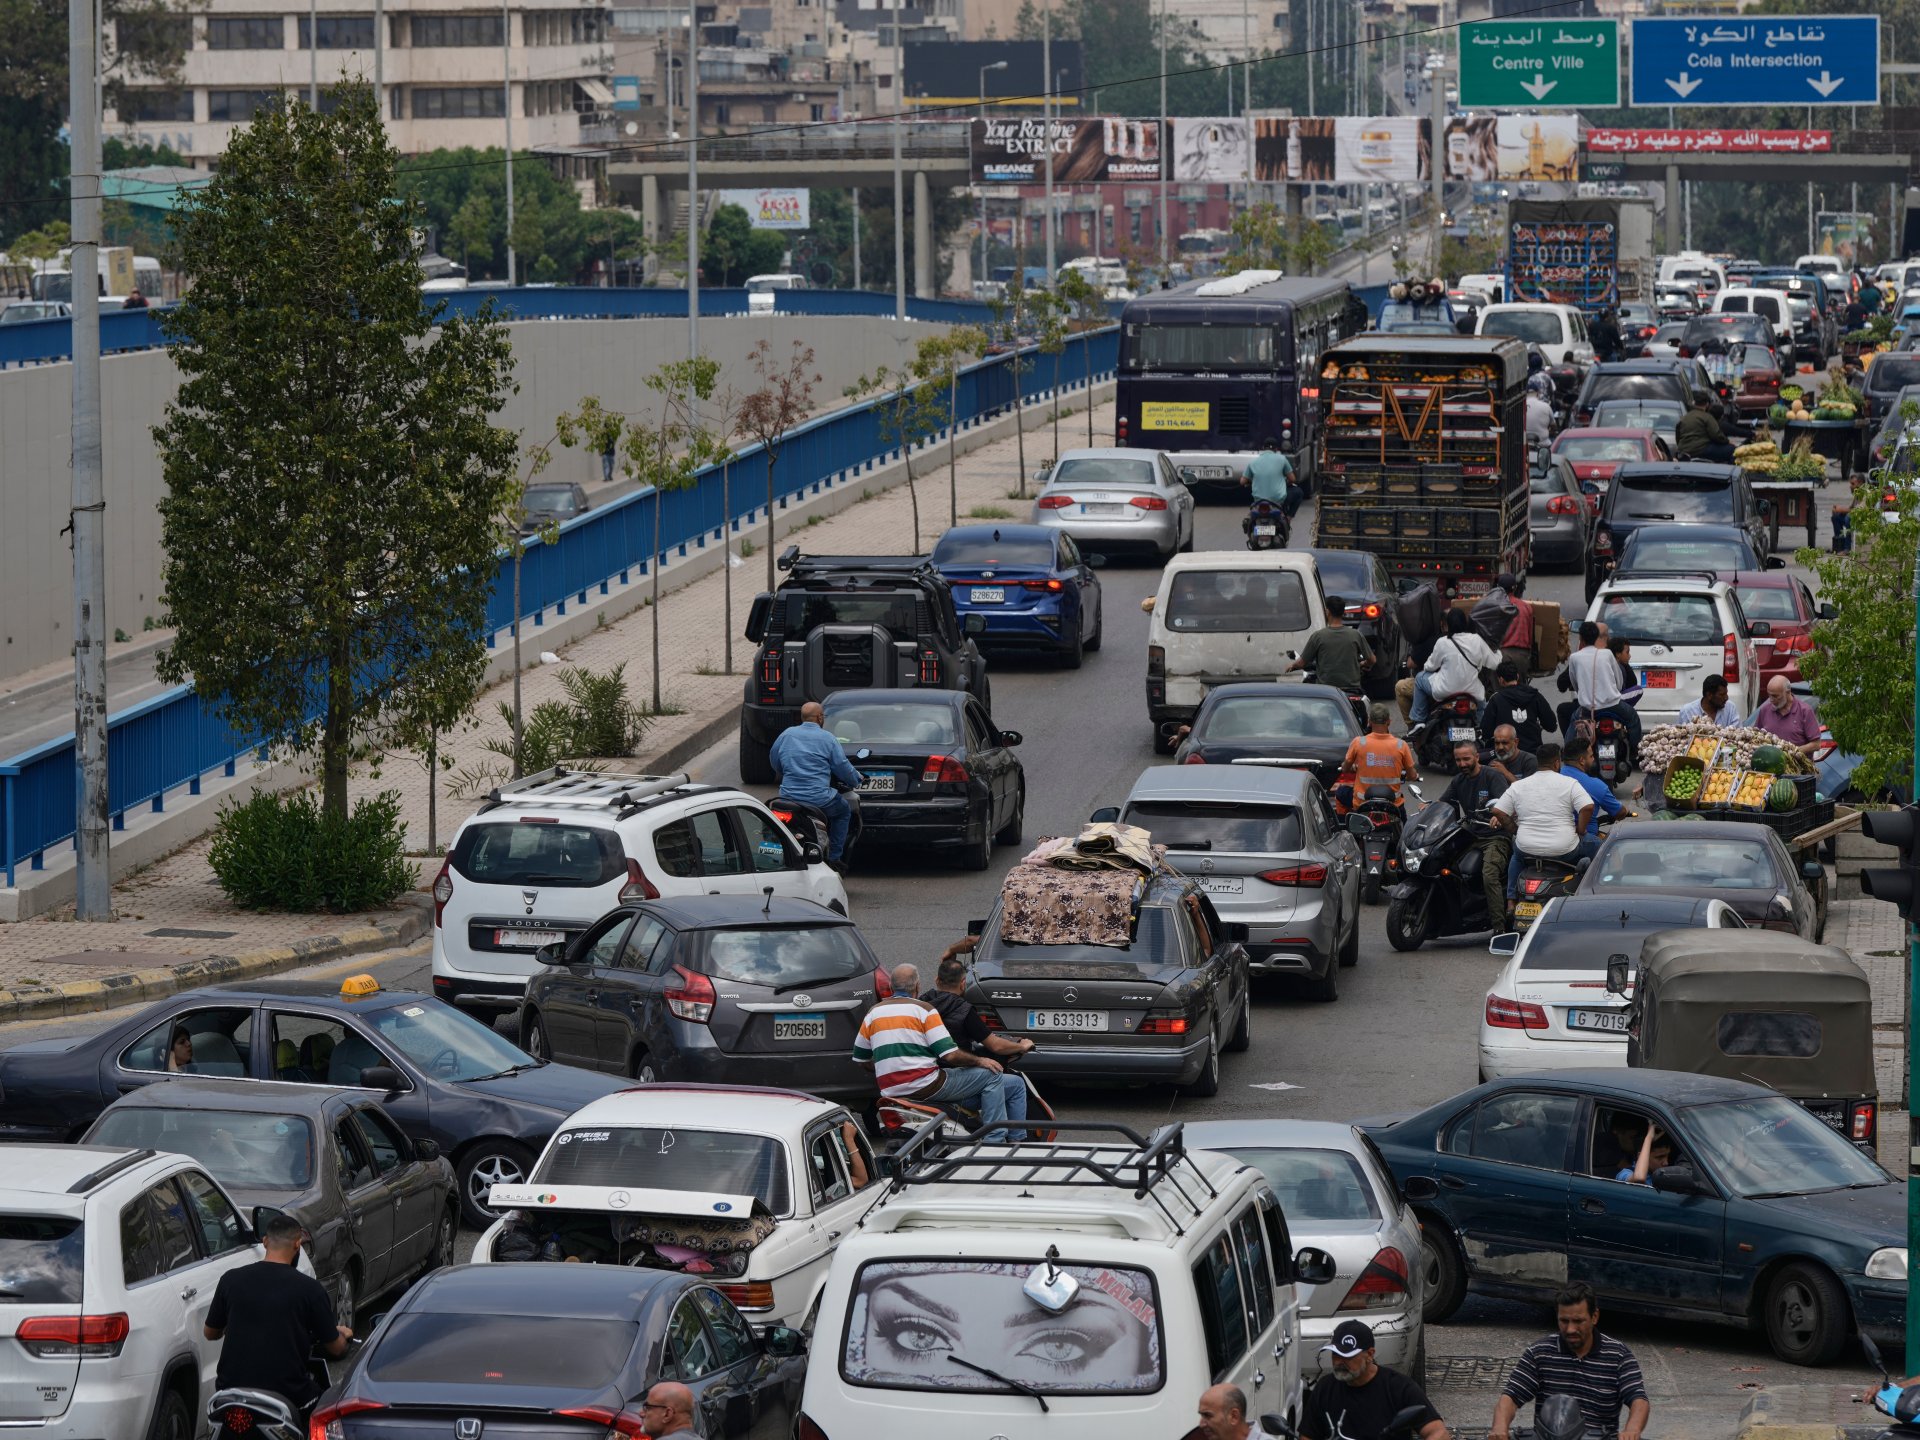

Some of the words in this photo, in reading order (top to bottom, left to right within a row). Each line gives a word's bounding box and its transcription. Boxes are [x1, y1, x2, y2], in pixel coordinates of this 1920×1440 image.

[1472, 28, 1542, 48] المدينة
[1552, 29, 1605, 47] وسط
[1685, 25, 1755, 46] الكولا
[1764, 25, 1826, 47] تقاطع
[1492, 56, 1544, 69] Centre
[1552, 56, 1584, 69] Ville
[1687, 53, 1722, 68] Cola
[1731, 53, 1822, 67] Intersection
[984, 120, 1019, 138] Your
[1591, 133, 1639, 150] زوجته
[1643, 137, 1681, 149] عليه
[1762, 137, 1800, 150] يسب
[1802, 133, 1827, 150] من
[984, 164, 1034, 172] ELEGANCE
[1108, 164, 1160, 173] ELEGANCE
[760, 210, 801, 220] MALL
[1527, 245, 1597, 264] TOYOTA
[972, 591, 1004, 600] S286270
[855, 779, 894, 789] 72883
[359, 980, 376, 990] TAXI
[1037, 1013, 1046, 1026] G
[1053, 1013, 1099, 1027] 633913
[1579, 1012, 1586, 1026] G
[1594, 1014, 1626, 1030] 7019
[775, 1023, 825, 1037] B705681
[1093, 1270, 1156, 1327] MALAK
